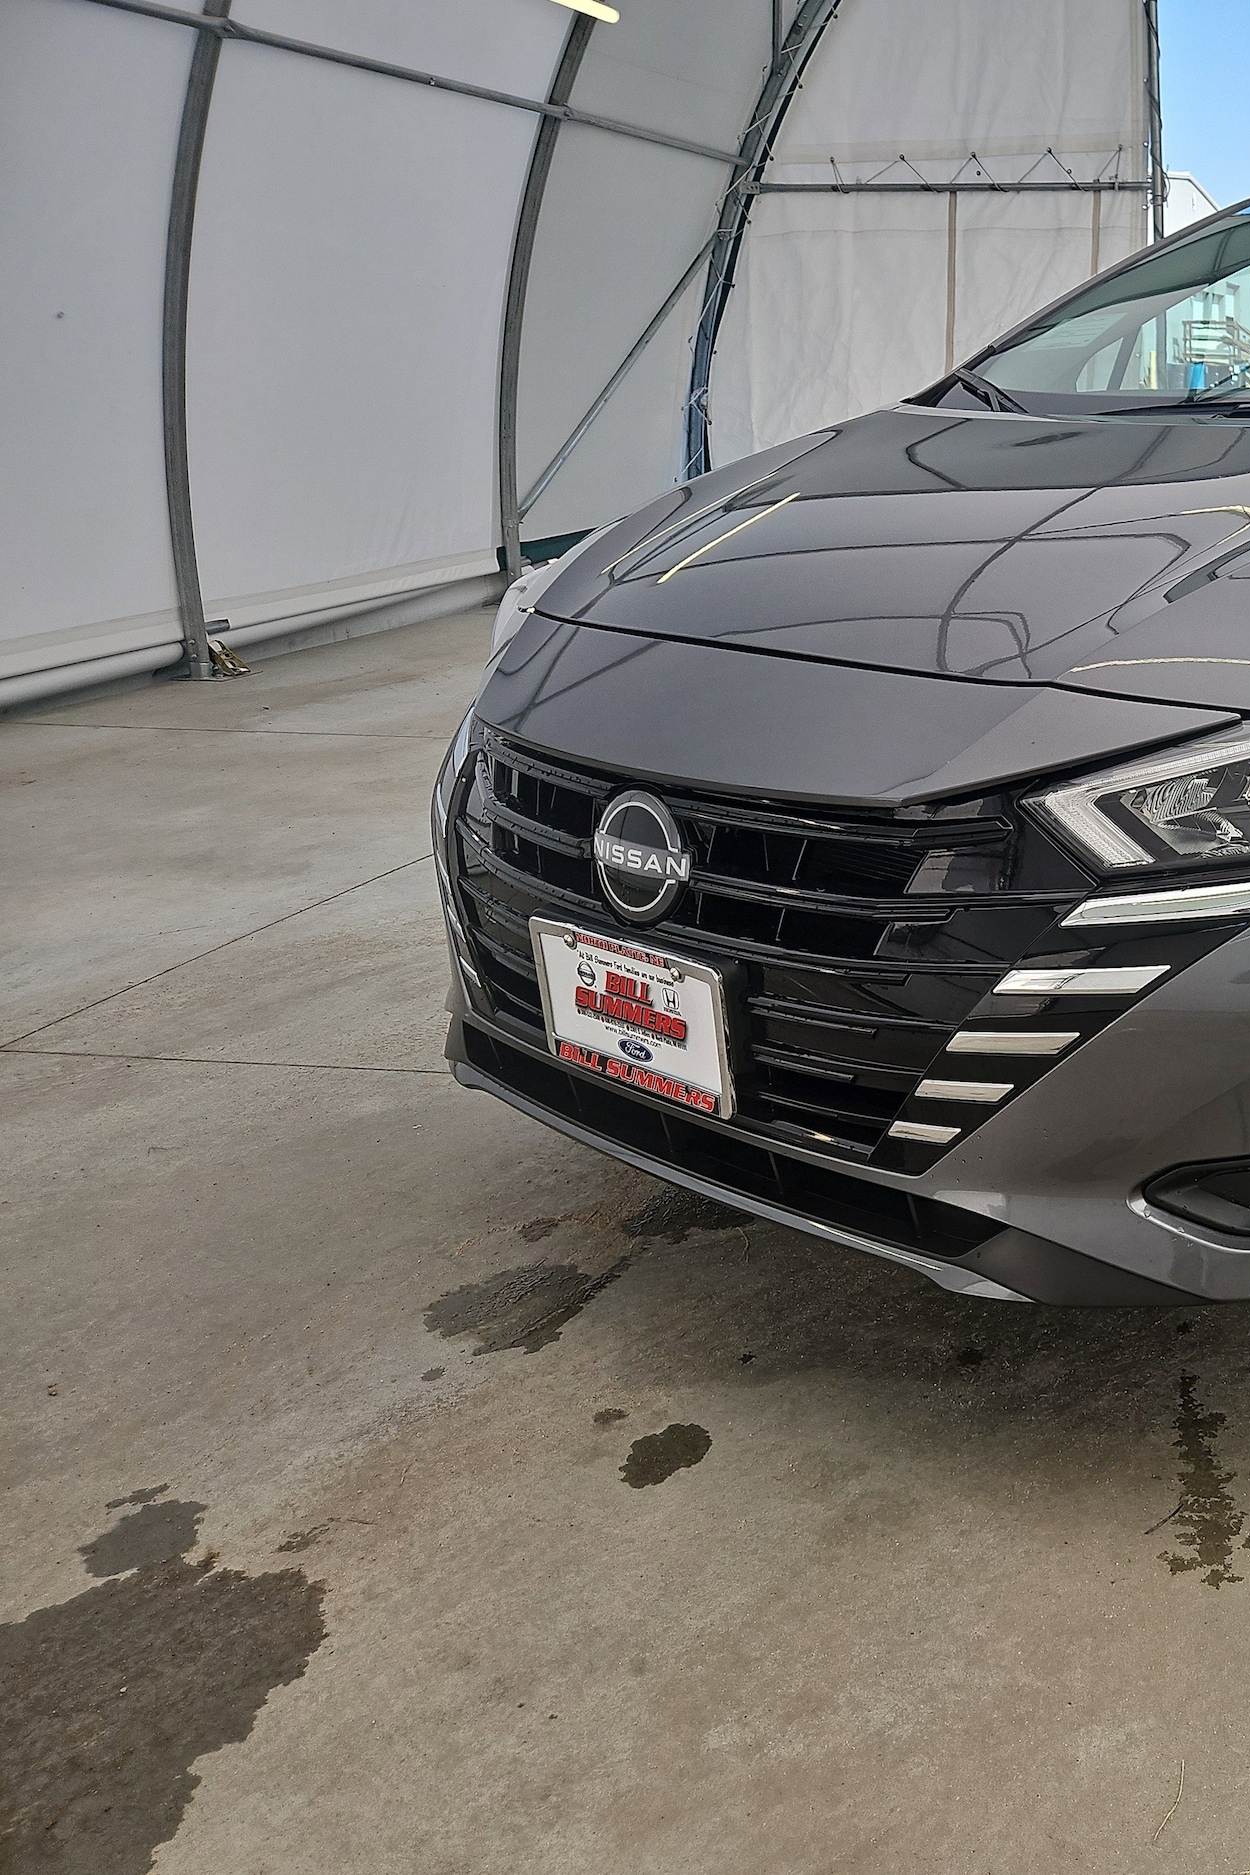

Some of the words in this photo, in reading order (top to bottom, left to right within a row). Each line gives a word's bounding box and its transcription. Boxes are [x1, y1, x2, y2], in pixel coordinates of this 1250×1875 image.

[594, 836, 687, 877] NISSAN
[613, 961, 623, 972] Ford
[606, 971, 651, 1004] BILL
[575, 986, 686, 1040] SUMMERS
[624, 1041, 647, 1059] Ford
[558, 1041, 604, 1071] BILL
[605, 1059, 716, 1113] SUMMERS
